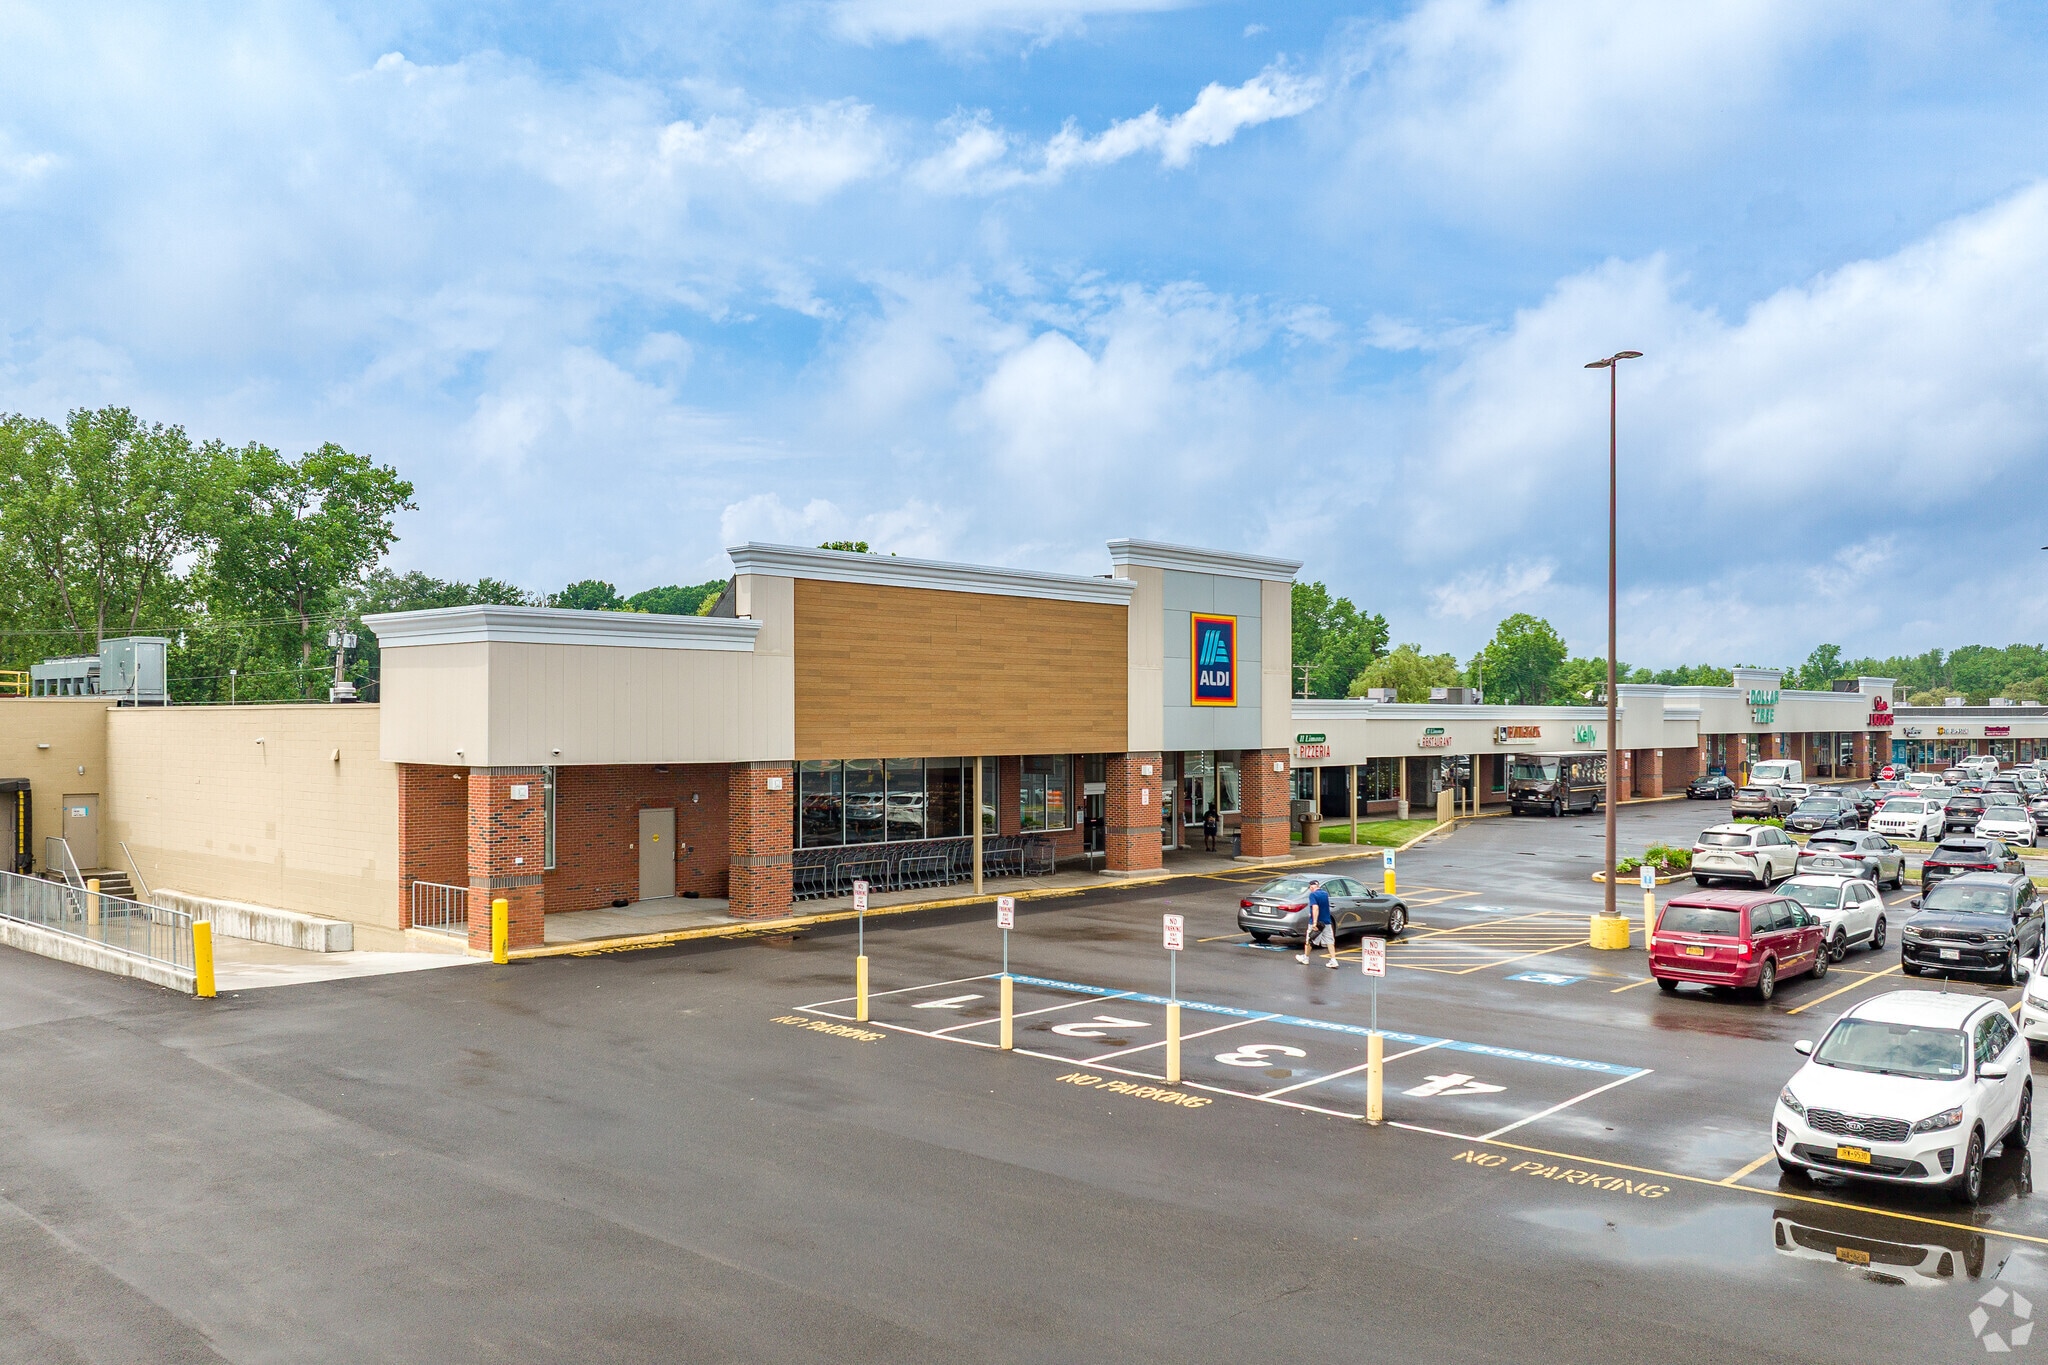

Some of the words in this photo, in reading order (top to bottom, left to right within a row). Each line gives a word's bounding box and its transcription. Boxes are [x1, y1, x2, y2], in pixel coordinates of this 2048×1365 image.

[1200, 670, 1229, 686] ALDI
[1750, 690, 1779, 705] DOLLAR
[1755, 708, 1774, 723] TREE
[1305, 734, 1325, 742] Limone
[1422, 737, 1452, 747] RESTAURANT
[1577, 725, 1597, 747] Kelly
[1300, 745, 1331, 758] PIZZERIA
[1364, 949, 1383, 957] PARKING
[1369, 941, 1378, 949] NO
[912, 994, 984, 1008] 1
[770, 1016, 808, 1024] NO
[798, 1021, 886, 1041] PARKING
[1051, 1016, 1152, 1037] 2
[1293, 1018, 1416, 1041] CURBSIDE
[1214, 1044, 1307, 1067] 3
[1468, 1045, 1612, 1070] CURBSIDE
[1056, 1073, 1102, 1086] NO
[1095, 1080, 1213, 1108] PARKING
[1402, 1073, 1507, 1097] 4
[1848, 1122, 1861, 1130] KIA
[1451, 1150, 1507, 1167] NO
[1509, 1161, 1670, 1198] PARKING
